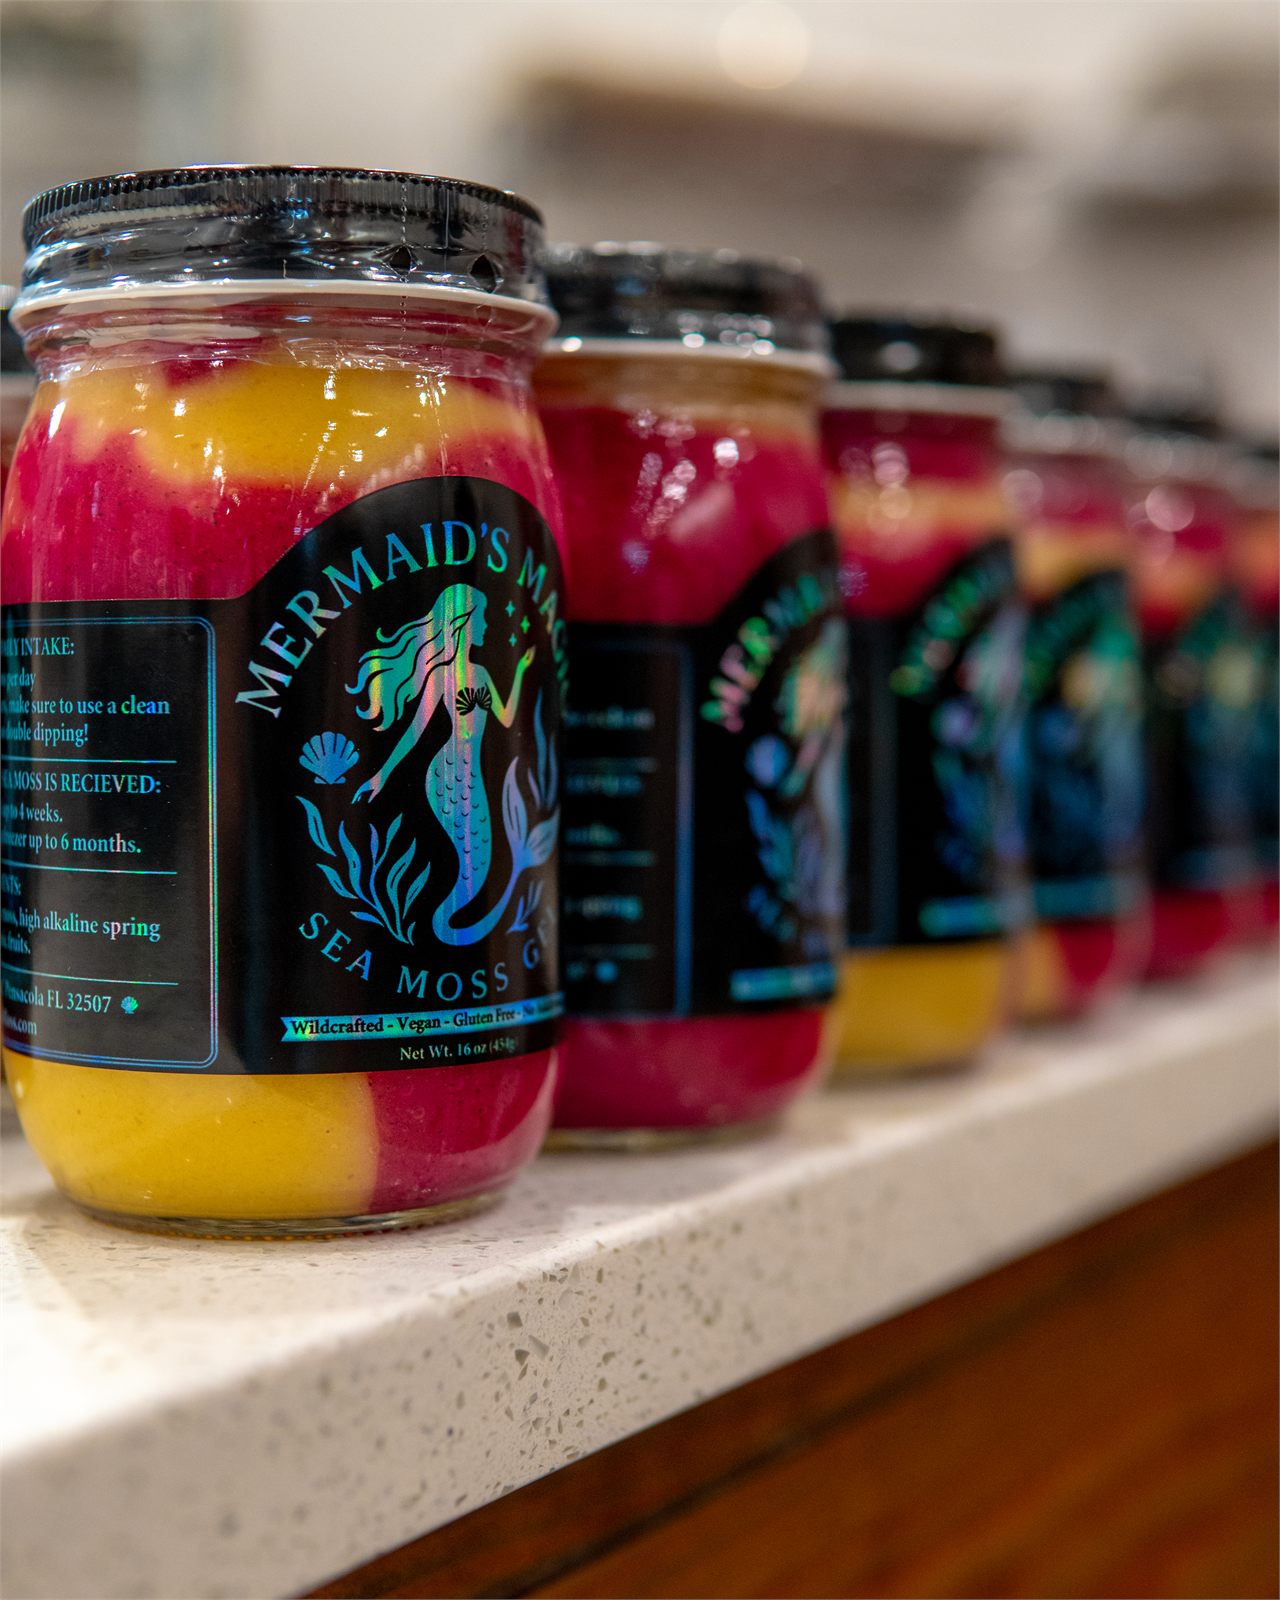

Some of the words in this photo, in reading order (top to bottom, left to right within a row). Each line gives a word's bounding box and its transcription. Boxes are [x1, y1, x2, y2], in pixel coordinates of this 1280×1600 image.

[235, 519, 510, 719] MERMAID'S
[20, 636, 75, 656] INTAKE:
[19, 667, 36, 692] day
[31, 700, 56, 714] sure
[59, 697, 74, 714] to
[77, 700, 103, 714] use
[107, 701, 117, 714] a
[121, 694, 171, 714] clean
[33, 721, 89, 748] dipping!
[44, 772, 58, 792] IS
[60, 773, 162, 793] RECIEVED:
[26, 802, 63, 823] weeks.
[28, 834, 43, 854] up
[45, 833, 58, 850] to
[60, 832, 69, 850] 6
[72, 833, 142, 854] months.
[19, 906, 41, 933] high
[43, 910, 99, 934] alkaline
[102, 916, 161, 943] spring
[298, 912, 373, 981] SEA
[396, 961, 509, 1001] MOSS
[47, 989, 63, 1009] FL
[66, 992, 112, 1014] 32507
[290, 1017, 385, 1036] Wildcrafted
[397, 1016, 442, 1034] Vegan
[453, 1011, 493, 1027] Gluten
[495, 1007, 515, 1021] Free
[400, 1046, 425, 1062] Net
[428, 1045, 454, 1059] Wt.
[457, 1042, 472, 1057] 16
[473, 1043, 487, 1055] oz
